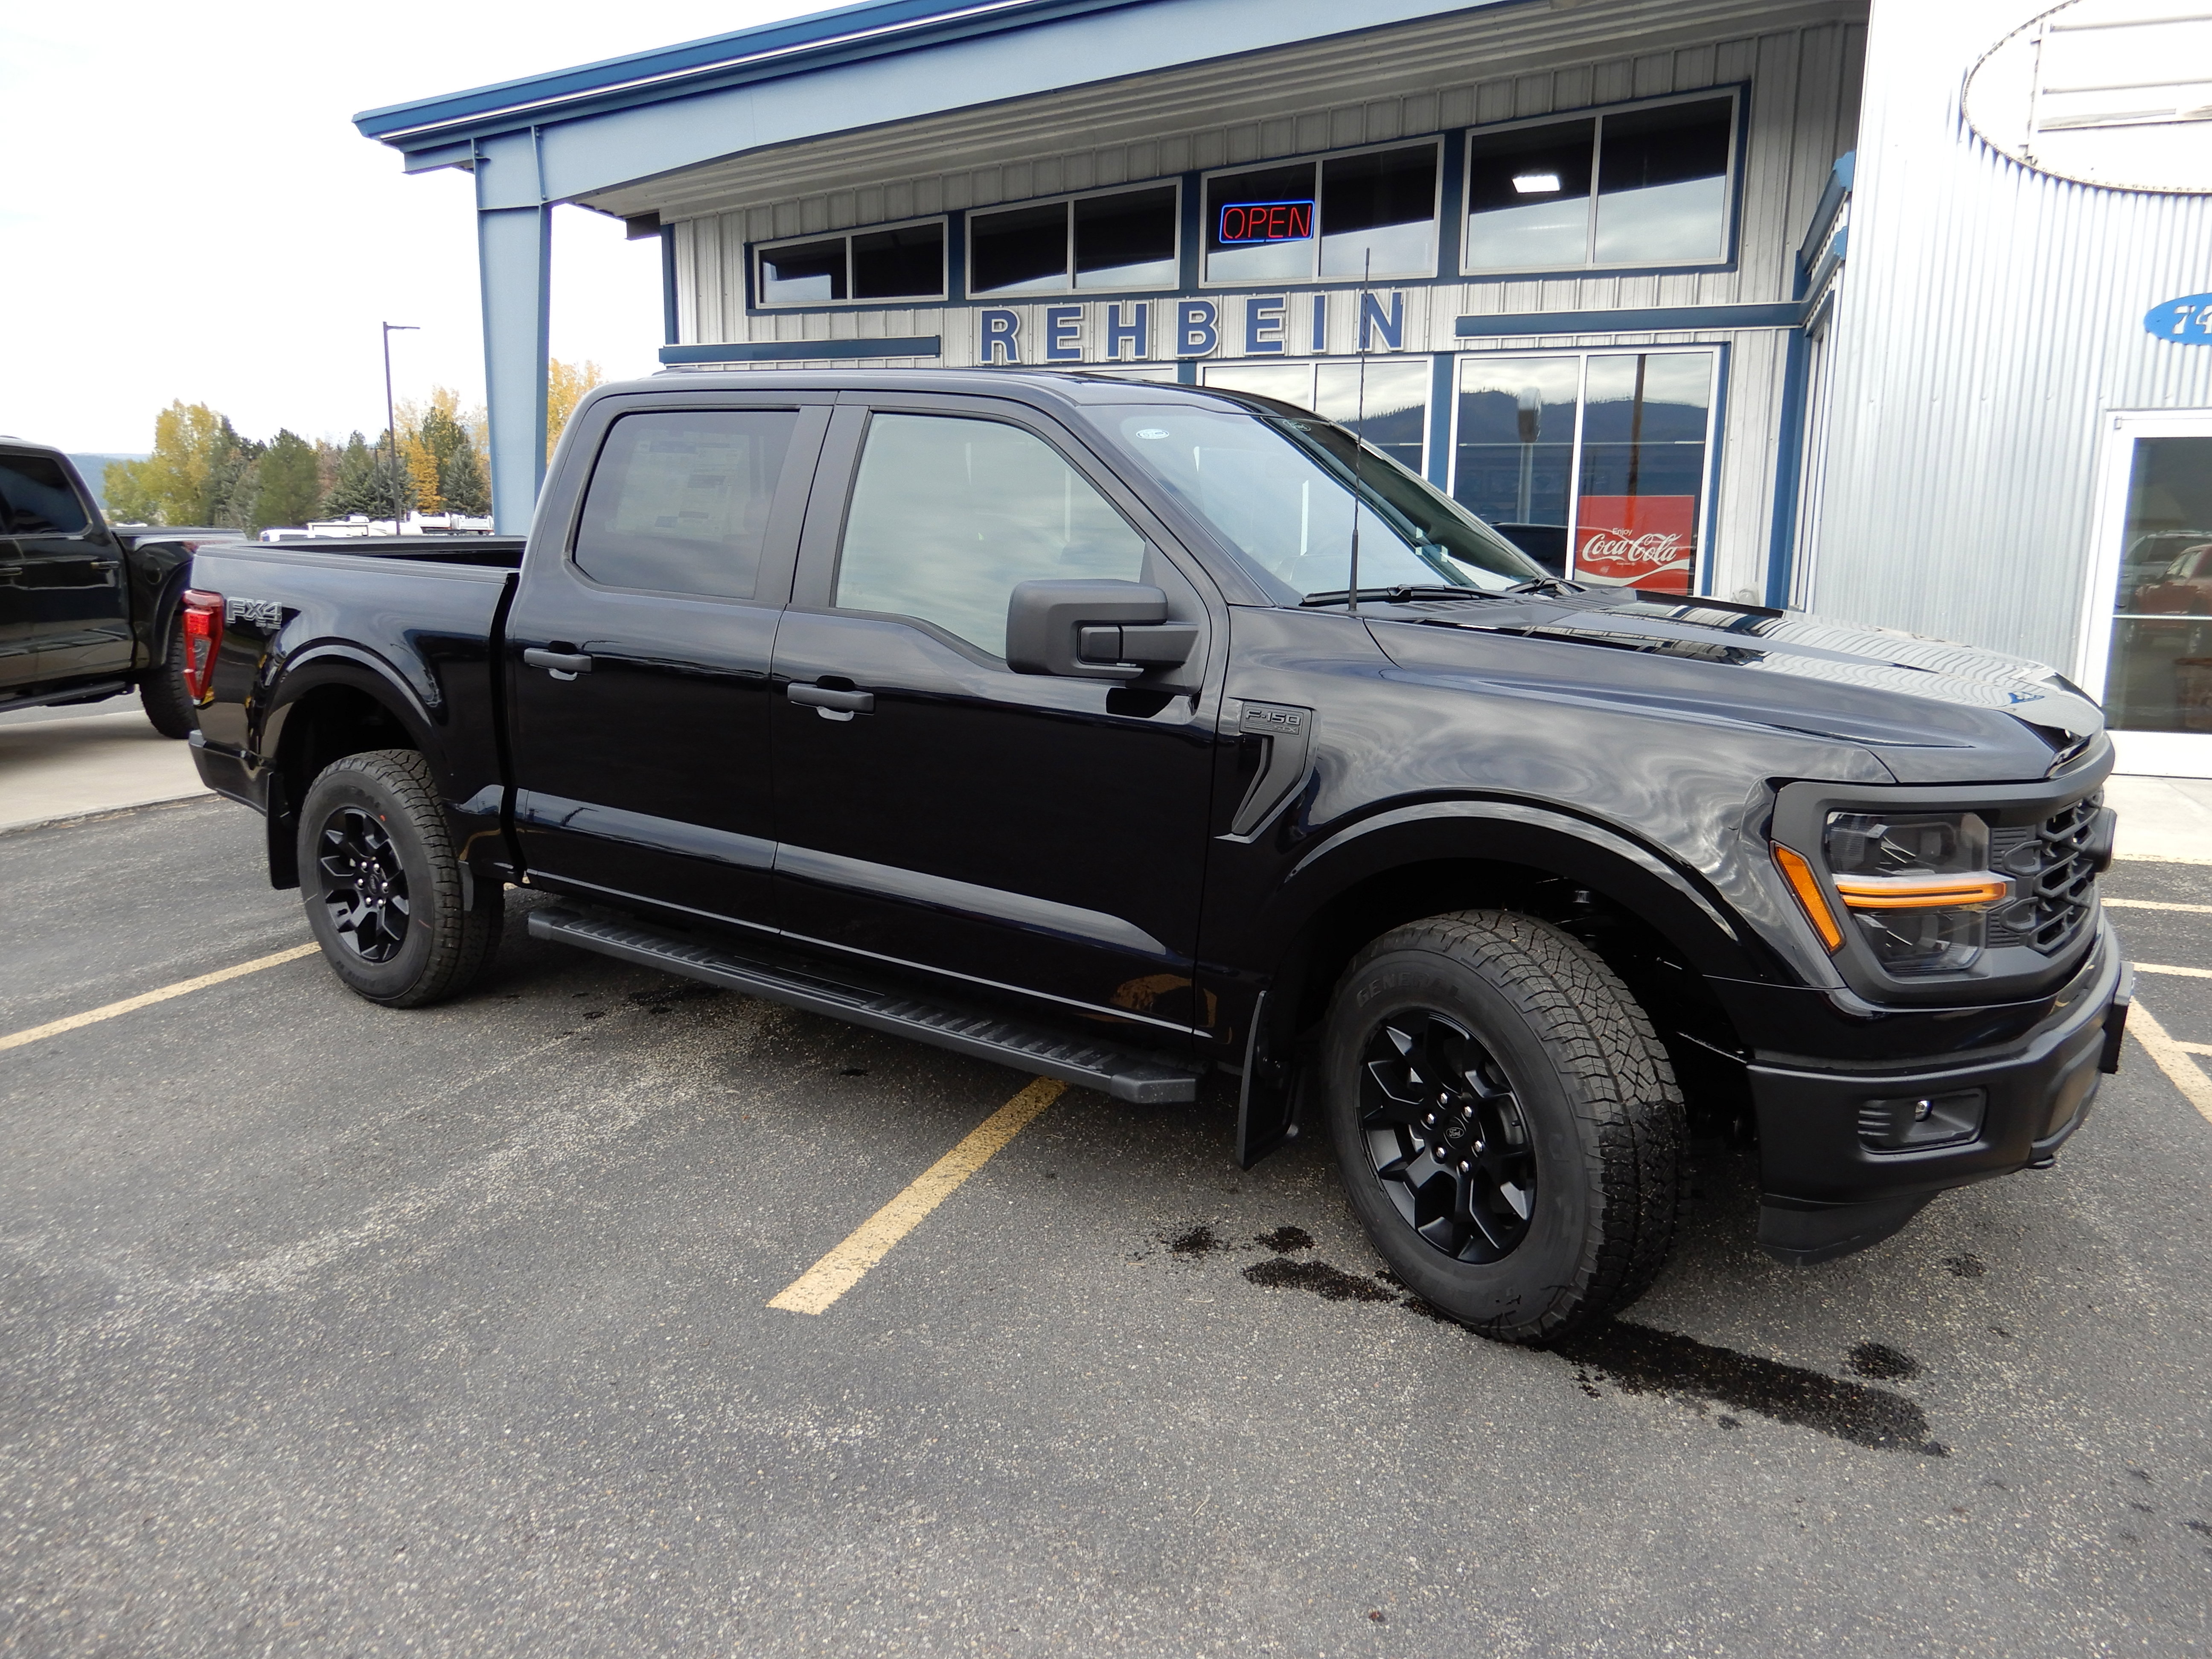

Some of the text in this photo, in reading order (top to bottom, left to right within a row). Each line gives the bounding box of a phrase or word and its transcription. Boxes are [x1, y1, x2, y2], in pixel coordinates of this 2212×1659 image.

[1223, 205, 1311, 239] OPEN
[980, 289, 1406, 364] REHBEIN
[1612, 528, 1633, 536] Enjoy
[226, 597, 282, 624] FX4
[1246, 710, 1301, 725] F-150
